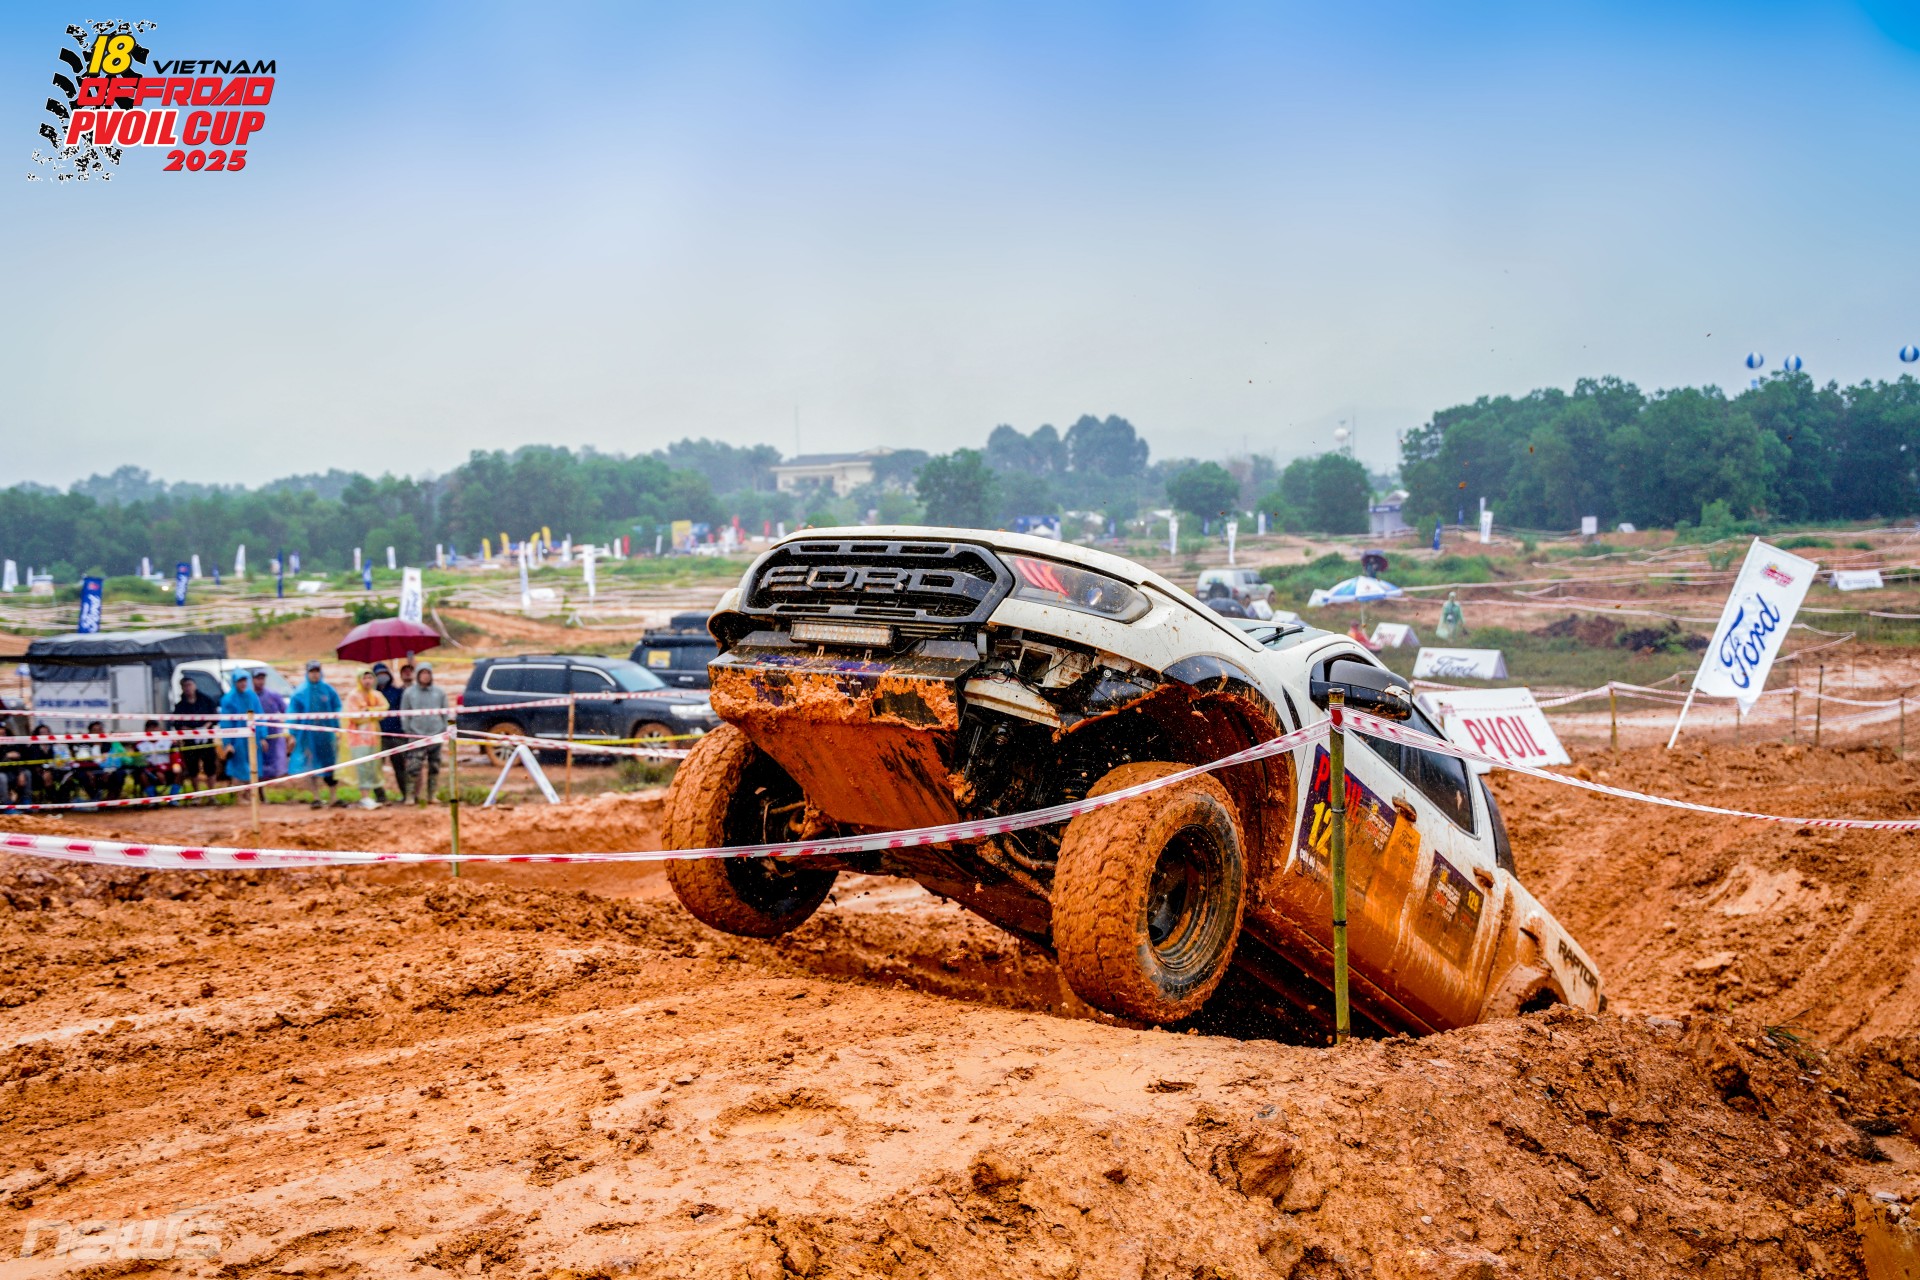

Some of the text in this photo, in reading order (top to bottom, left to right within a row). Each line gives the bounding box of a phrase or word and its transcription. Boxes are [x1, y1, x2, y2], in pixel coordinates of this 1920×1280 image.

[760, 565, 965, 595] FORD
[1719, 592, 1781, 690] Ford
[1429, 654, 1480, 677] Ford
[1462, 715, 1547, 760] PVOIL
[1557, 938, 1599, 989] RAPTOR
